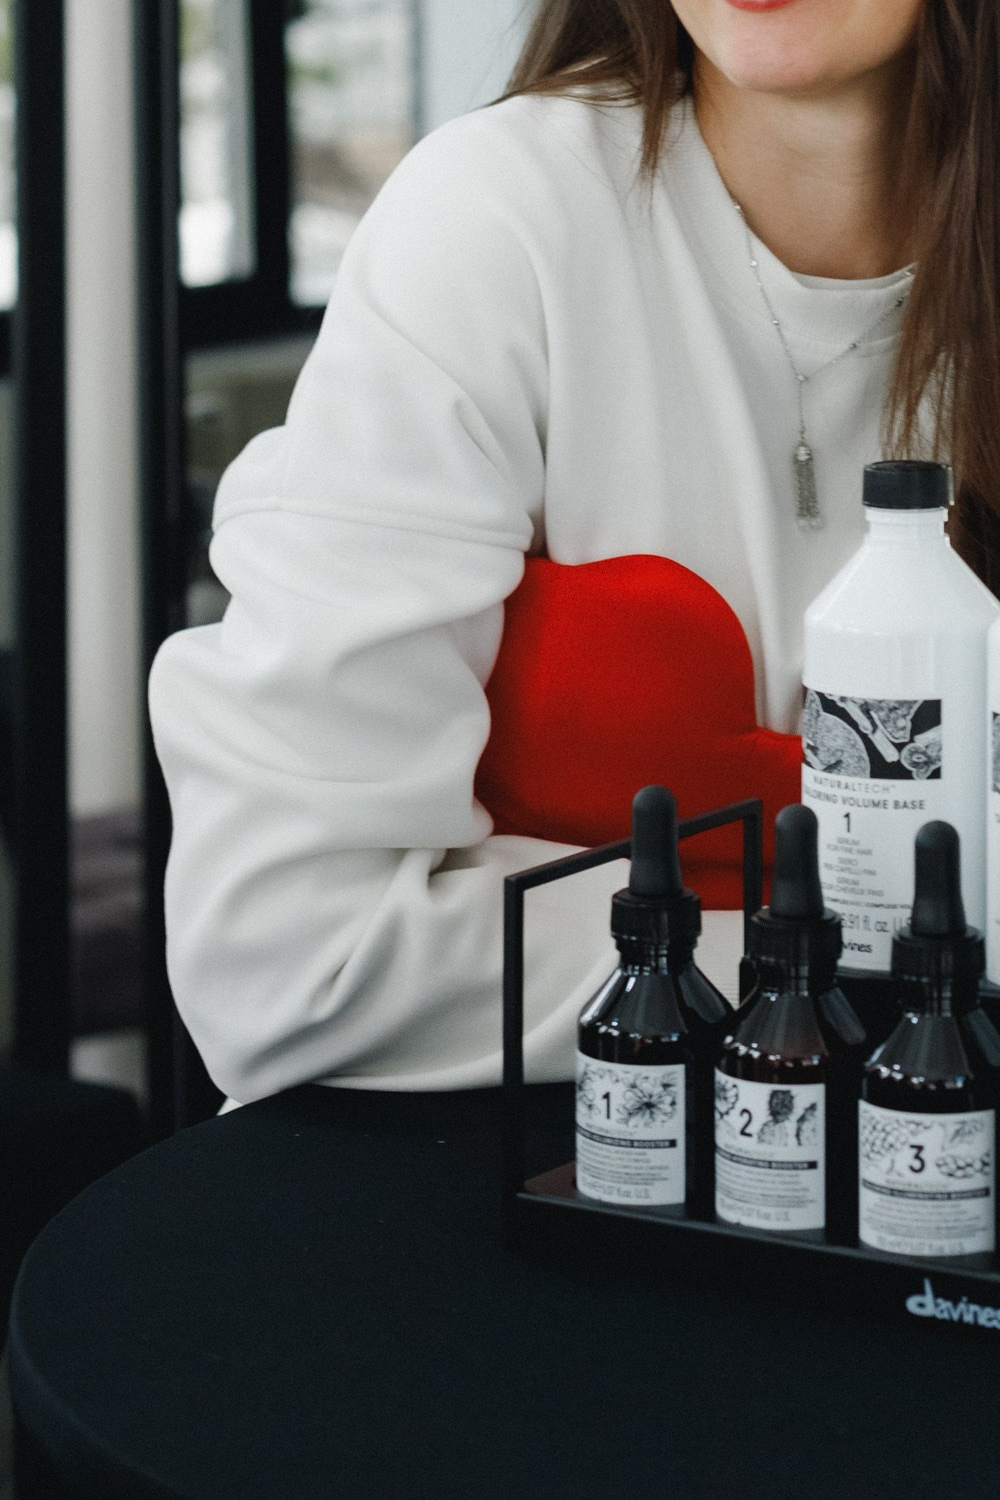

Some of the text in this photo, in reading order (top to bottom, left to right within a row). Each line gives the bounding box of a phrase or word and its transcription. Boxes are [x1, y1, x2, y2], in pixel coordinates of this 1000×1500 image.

[841, 795, 889, 810] VOLUME
[893, 800, 926, 810] BASE
[843, 812, 851, 833] 1
[841, 940, 873, 953] vines
[602, 1091, 611, 1120] 1
[739, 1108, 753, 1137] 2
[908, 1144, 926, 1174] 3
